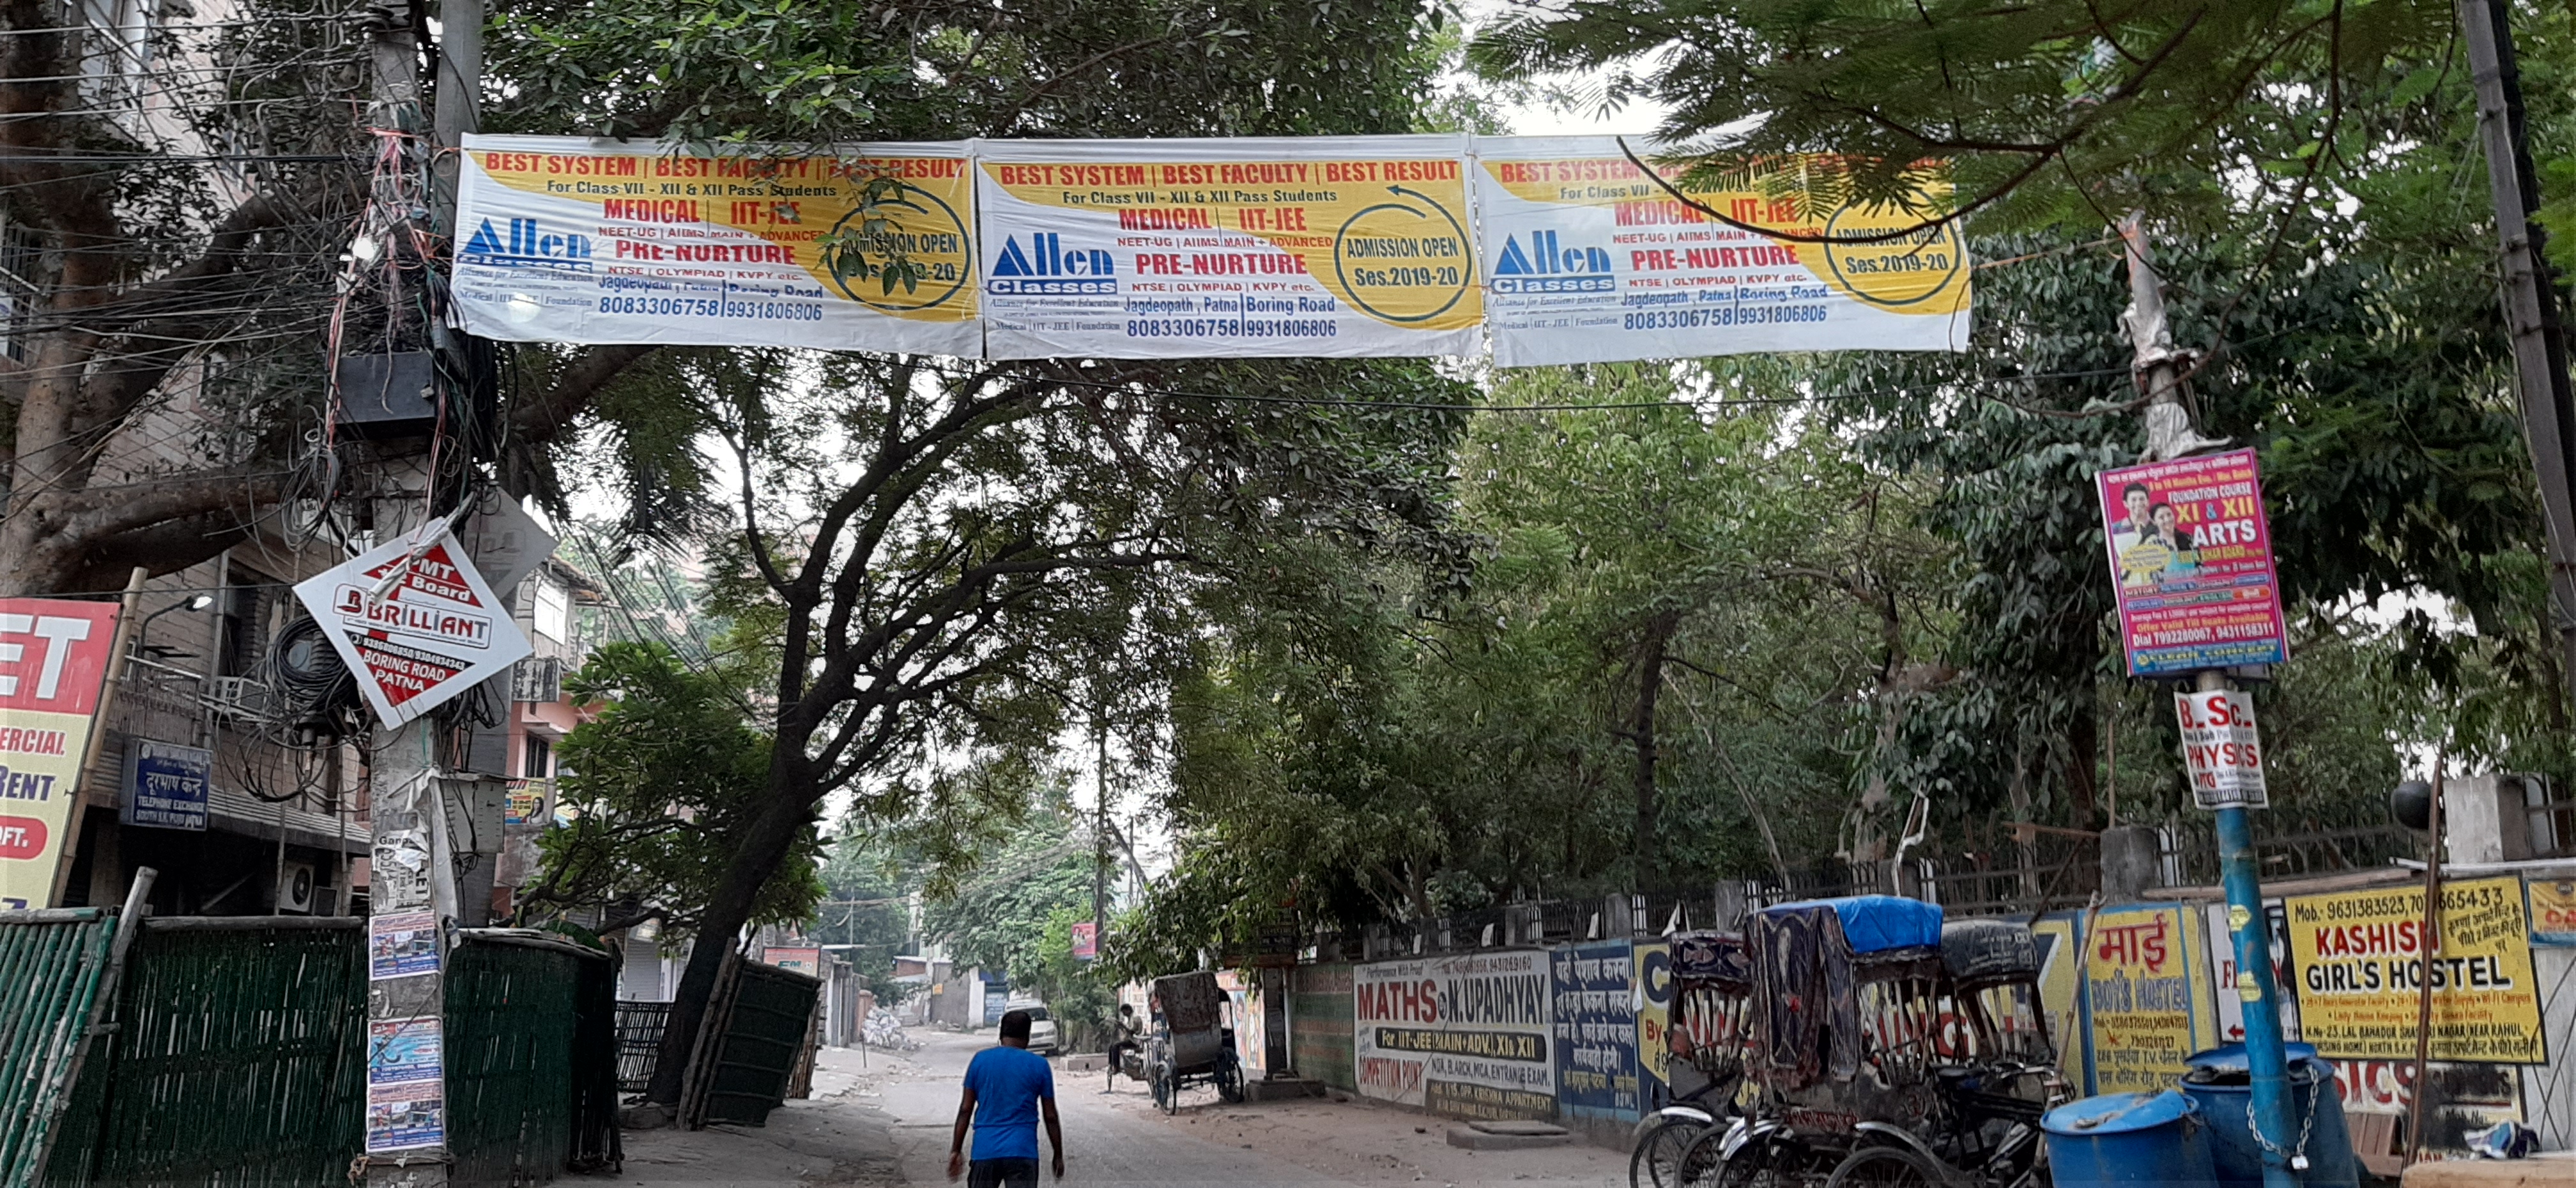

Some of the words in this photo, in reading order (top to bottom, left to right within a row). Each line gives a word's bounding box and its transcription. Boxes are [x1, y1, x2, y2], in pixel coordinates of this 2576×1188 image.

[486, 152, 542, 172] BEST
[548, 156, 636, 176] SYSTEM
[656, 158, 712, 178] BEST
[889, 159, 967, 179] RESULT
[999, 165, 1054, 186] BEST
[1059, 165, 1146, 186] SYSTEM
[1162, 164, 1215, 185] BEST
[1221, 163, 1308, 185] FACULTY
[1326, 162, 1378, 183] BEST
[1383, 160, 1459, 181] RESULT
[1500, 162, 1552, 183] BEST
[1558, 160, 1640, 182] SYSTEM
[548, 180, 572, 193] For
[576, 181, 618, 194] Class
[624, 182, 644, 195] VII
[660, 183, 680, 195] XII
[686, 183, 698, 195] &
[702, 183, 723, 196] XII
[728, 185, 763, 196] Pass
[1063, 192, 1087, 204] For
[1090, 191, 1131, 204] Class
[1135, 191, 1155, 203] VII
[1170, 191, 1189, 204] XII
[1195, 191, 1205, 203] &
[1210, 190, 1229, 203] XII
[1235, 190, 1268, 202] Pass
[1273, 190, 1337, 202] Students
[1560, 186, 1582, 199] For
[1587, 185, 1626, 199] Class
[1630, 185, 1650, 196] VII
[604, 198, 701, 223] MEDICAL
[1118, 208, 1213, 231] MEDICAL
[1238, 207, 1308, 231] IIT-JEE
[1614, 198, 1705, 227] MEDICAL
[1731, 197, 1797, 224] IIT-JEE
[461, 217, 592, 258] Allen
[598, 226, 656, 238] NEET-UG
[1117, 237, 1173, 247] NEET-UG
[1183, 237, 1219, 247] AIIMS
[1224, 236, 1255, 248] MAIN
[1269, 236, 1334, 248] ADVANCED
[1613, 232, 1667, 243] NEET-UG
[1676, 231, 1711, 242] AIIMS
[1716, 230, 1747, 241] MAIN
[615, 238, 795, 266] PRE-NURTURE
[921, 234, 958, 254] OPEN
[992, 232, 1115, 277] Allen
[1347, 237, 1419, 259] ADMISSION
[1422, 237, 1459, 257] OPEN
[1494, 229, 1611, 275] Allen
[1135, 253, 1308, 276] PRE-NURTURE
[1630, 245, 1799, 271] PRE-NURTURE
[1844, 253, 1949, 274] Ses.2019-20
[608, 266, 643, 275] NTSE
[656, 267, 724, 278] OLYMPIAD
[737, 270, 772, 280] KVPY
[1354, 266, 1459, 287] Ses.2019-20
[1493, 276, 1615, 293] Classes
[1629, 278, 1662, 287] NTSE
[1672, 275, 1736, 286] OLYMPIAD
[1746, 275, 1779, 284] KVPY
[990, 279, 1117, 295] Classes
[1131, 282, 1167, 293] NTSE
[1176, 282, 1242, 292] OLYMPIAD
[1253, 282, 1287, 292] KVPY
[1291, 282, 1315, 292] etc.
[1621, 291, 1689, 309] Jagdeopath
[1699, 289, 1732, 301] Patna
[1791, 285, 1828, 299] Road
[545, 296, 593, 307] Foundation
[599, 296, 719, 317] 8083306758
[727, 301, 822, 321] 9931806806
[1123, 296, 1194, 316] Jagdeopath
[1204, 296, 1238, 313] Patna
[1246, 297, 1294, 316] Boring
[1298, 296, 1335, 312] Road
[995, 321, 1027, 331] Medical
[1052, 321, 1070, 331] JEE
[1076, 321, 1121, 331] Foundation
[1127, 319, 1239, 338] 8083306758
[1246, 319, 1337, 337] 9931806806
[1624, 308, 1733, 330] 8083306758
[1740, 305, 1827, 324] 9931806806
[2168, 487, 2220, 504] FOUNDATION
[2220, 482, 2253, 498] COURSE
[2175, 502, 2200, 524] XI
[2206, 502, 2218, 521] &
[2221, 496, 2255, 519] XII
[2193, 519, 2257, 548] ARTS
[412, 576, 471, 602] Board
[367, 602, 489, 639] BRILLIANT
[2133, 632, 2152, 648] Dial
[364, 650, 410, 671] BORING
[411, 662, 447, 682] ROAD
[374, 669, 425, 692] PATNA
[2188, 742, 2258, 770] PHYSICS
[2327, 895, 2409, 920] 9631383523,
[2306, 960, 2380, 993] GIRL'S
[2389, 955, 2511, 989] HOSTEL
[1358, 979, 1438, 1024] MATHS
[1448, 974, 1545, 1024] N.UPADHYAY
[1645, 1018, 1662, 1045] By
[2342, 1024, 2358, 1039] LAL
[2359, 1024, 2396, 1039] BAHADUR
[2437, 1023, 2466, 1038] NAGAR
[2492, 1022, 2523, 1037] RAHUL
[1382, 1029, 1395, 1046] For
[1517, 1036, 1535, 1058] XII
[1359, 1055, 1401, 1088] COMPETITION
[1403, 1059, 1423, 1092] POINT
[1527, 1067, 1551, 1087] EXAM.
